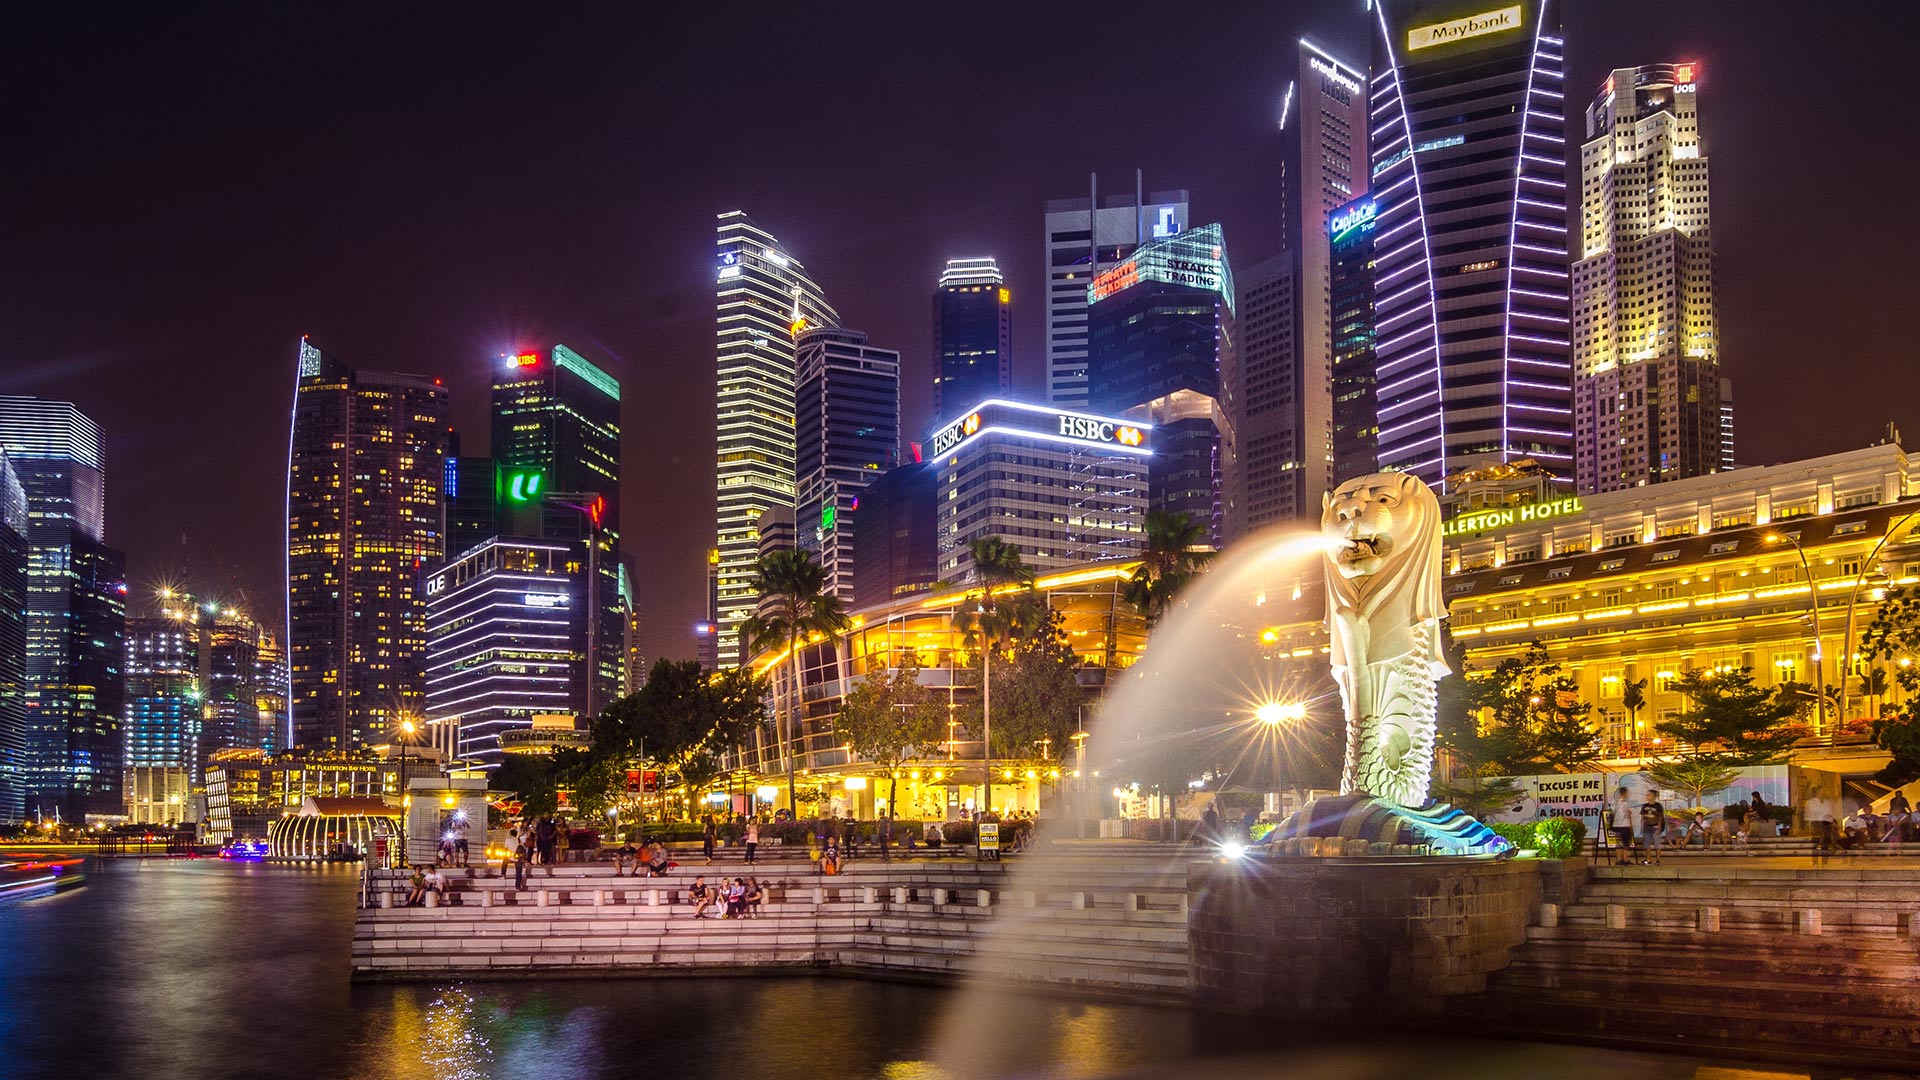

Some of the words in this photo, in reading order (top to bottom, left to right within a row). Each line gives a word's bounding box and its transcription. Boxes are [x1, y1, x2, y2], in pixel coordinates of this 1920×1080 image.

[1432, 13, 1510, 40] Maybank
[1674, 83, 1696, 94] UOB
[1167, 259, 1216, 275] STRAITS
[1164, 271, 1215, 286] TRADING
[517, 354, 537, 365] UBS
[1058, 415, 1113, 442] HSBC
[934, 421, 963, 456] HSBC
[1441, 509, 1514, 536] LLERTON
[1521, 497, 1583, 521] HOTEL
[427, 574, 445, 595] OUE
[1583, 780, 1600, 789] ME
[1539, 795, 1569, 804] WHILE
[1572, 794, 1577, 804] I
[1580, 794, 1604, 803] TAKE
[1540, 808, 1547, 818] A
[1549, 807, 1599, 818] SHOWER
